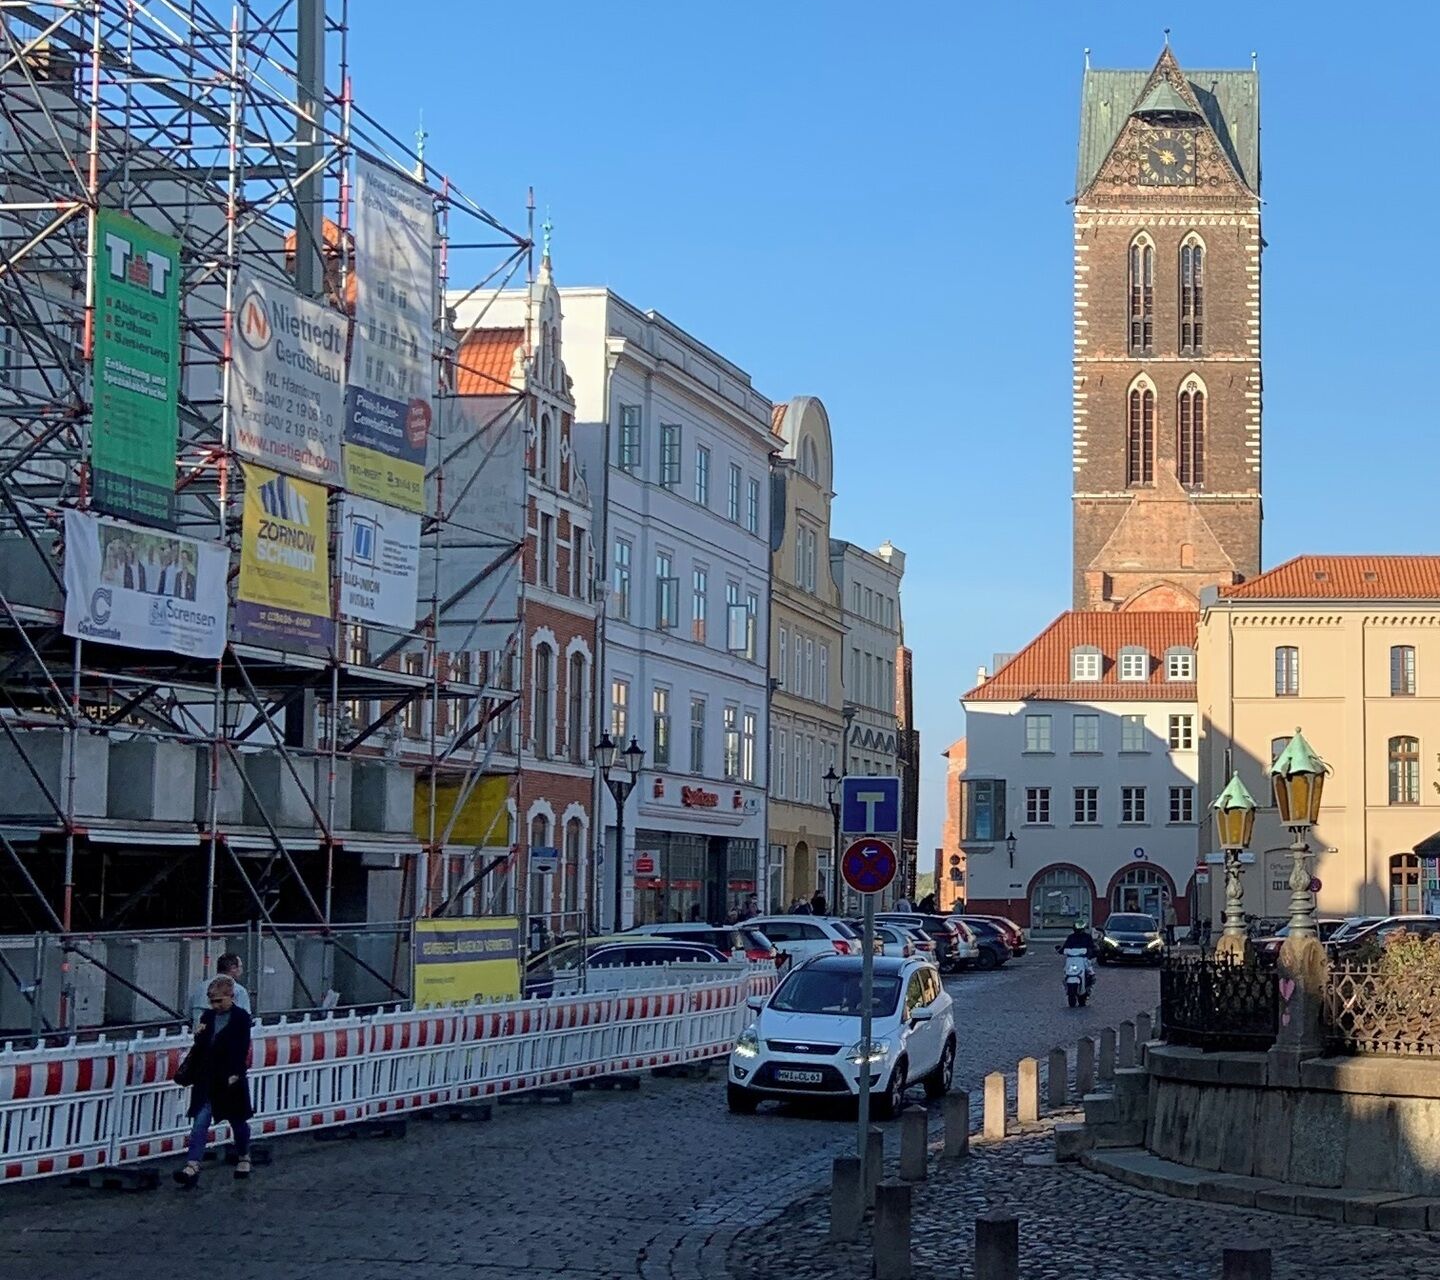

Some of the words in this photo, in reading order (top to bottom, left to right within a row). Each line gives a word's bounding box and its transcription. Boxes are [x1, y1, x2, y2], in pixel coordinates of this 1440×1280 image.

[114, 315, 151, 338] Erdbau
[115, 299, 158, 325] Abbruch
[272, 300, 341, 354] Nietiedt
[114, 331, 170, 363] Sanierung
[276, 339, 340, 384] Gerüstbau
[257, 520, 316, 553] ZORNOW
[256, 540, 316, 573] SCHMIDT
